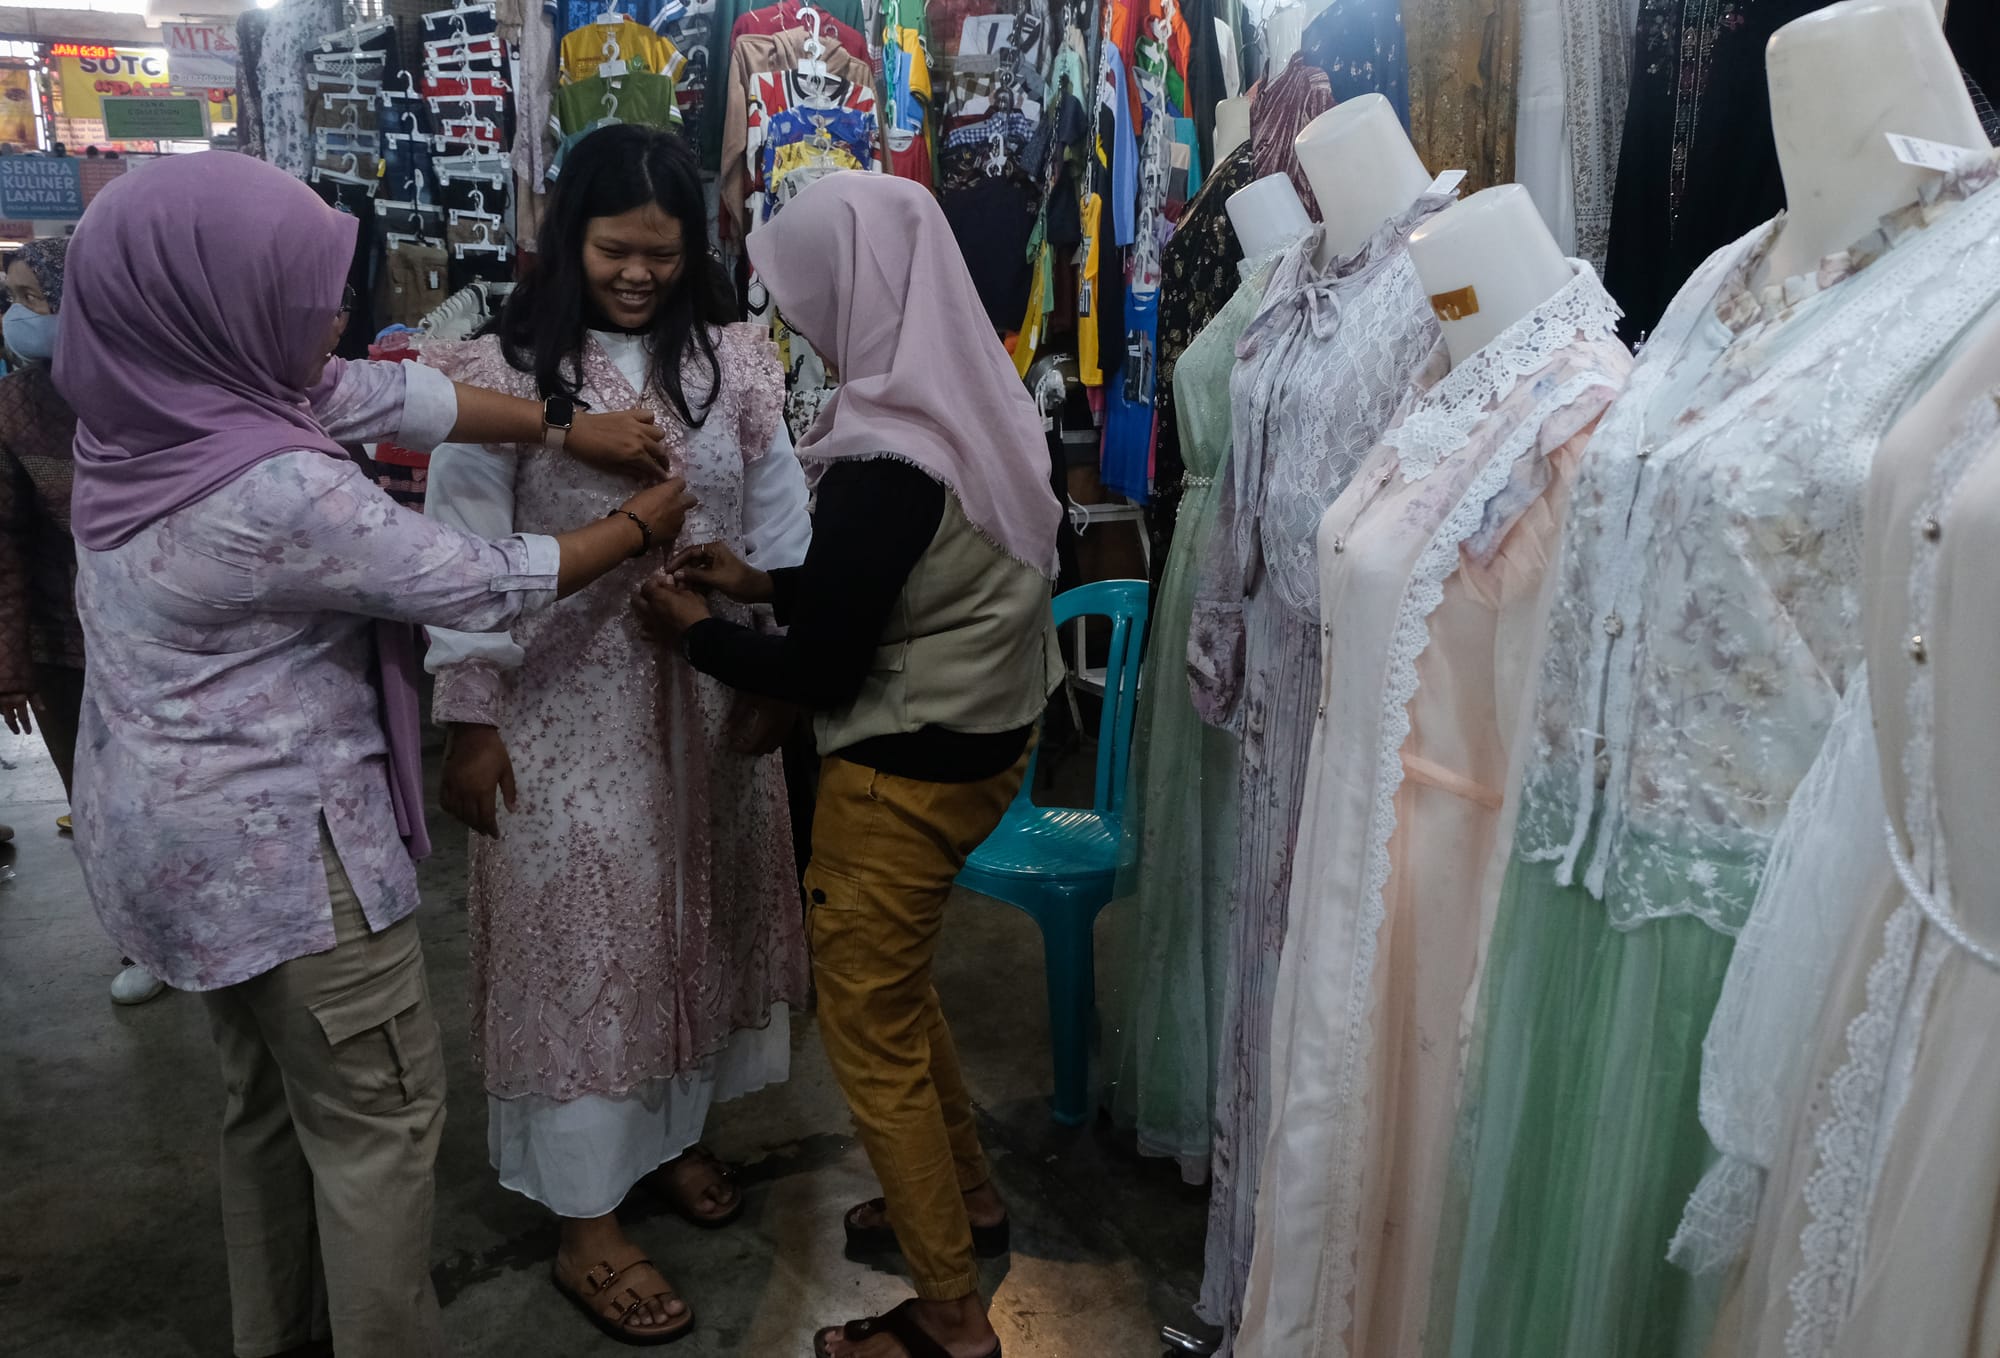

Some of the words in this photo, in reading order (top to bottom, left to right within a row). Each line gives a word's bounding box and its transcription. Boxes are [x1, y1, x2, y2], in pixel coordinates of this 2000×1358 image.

[51, 43, 78, 56] JAM
[80, 45, 105, 57] 6:30
[1, 160, 73, 176] SENTRA
[2, 175, 75, 190] KULINER
[5, 189, 61, 202] LANTAI
[65, 190, 77, 203] 2
